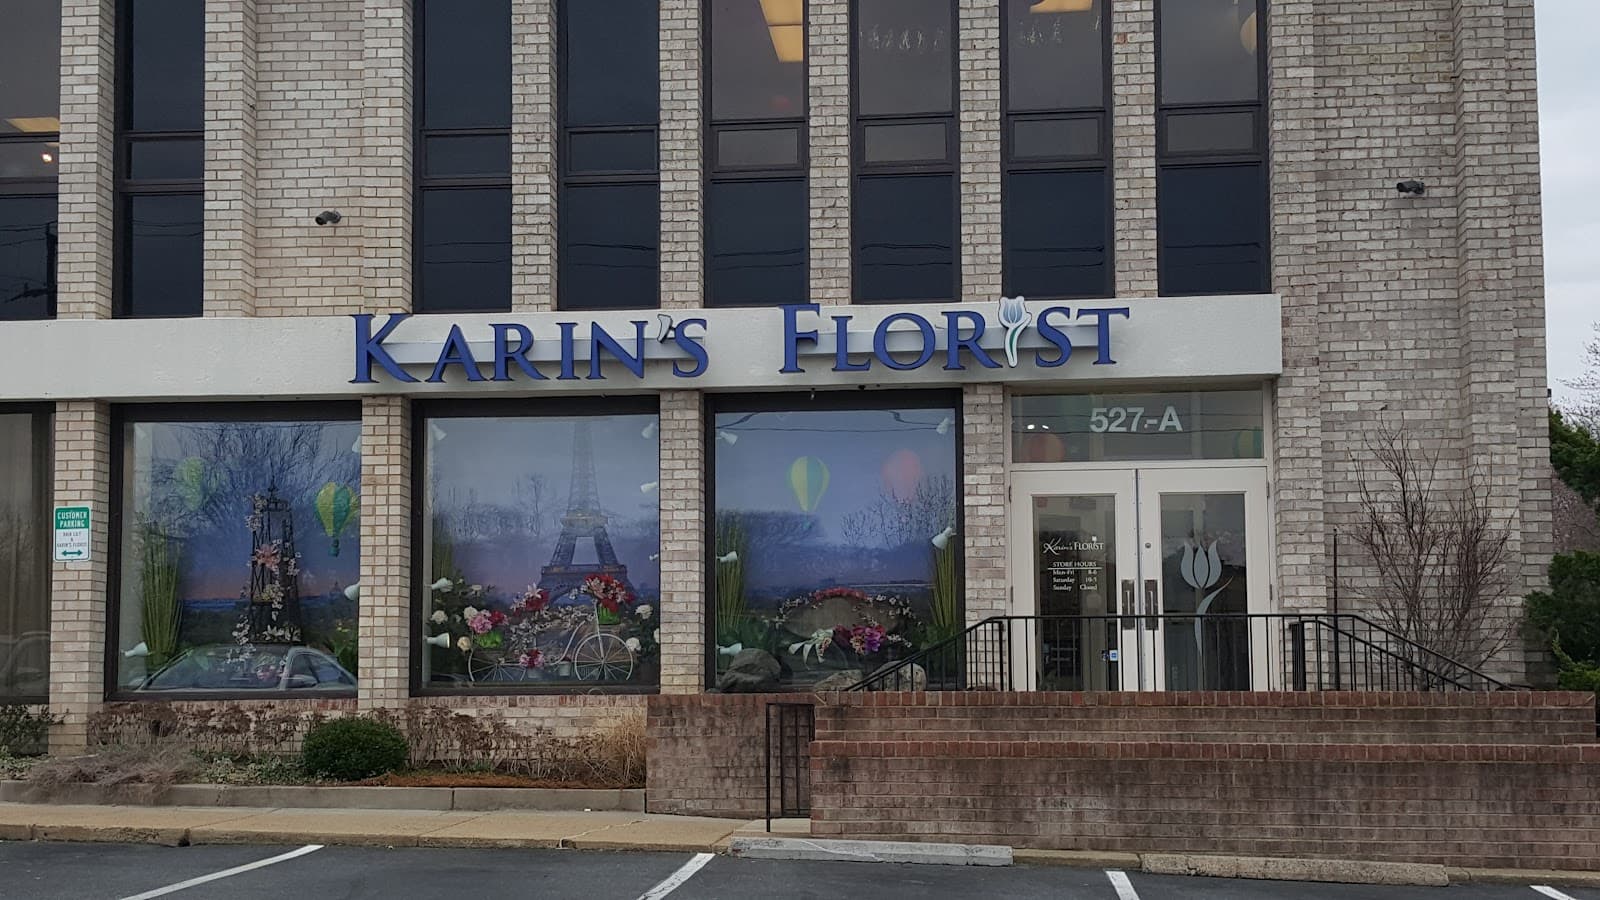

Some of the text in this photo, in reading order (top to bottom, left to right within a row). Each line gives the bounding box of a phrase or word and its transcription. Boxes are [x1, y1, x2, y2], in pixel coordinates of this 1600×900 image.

[348, 296, 1130, 383] KARIN'S FLORIST
[1089, 406, 1184, 433] 527-A
[57, 511, 88, 520] CUSTOMER
[59, 520, 85, 528] PARKING
[1052, 584, 1073, 592] Sunday
